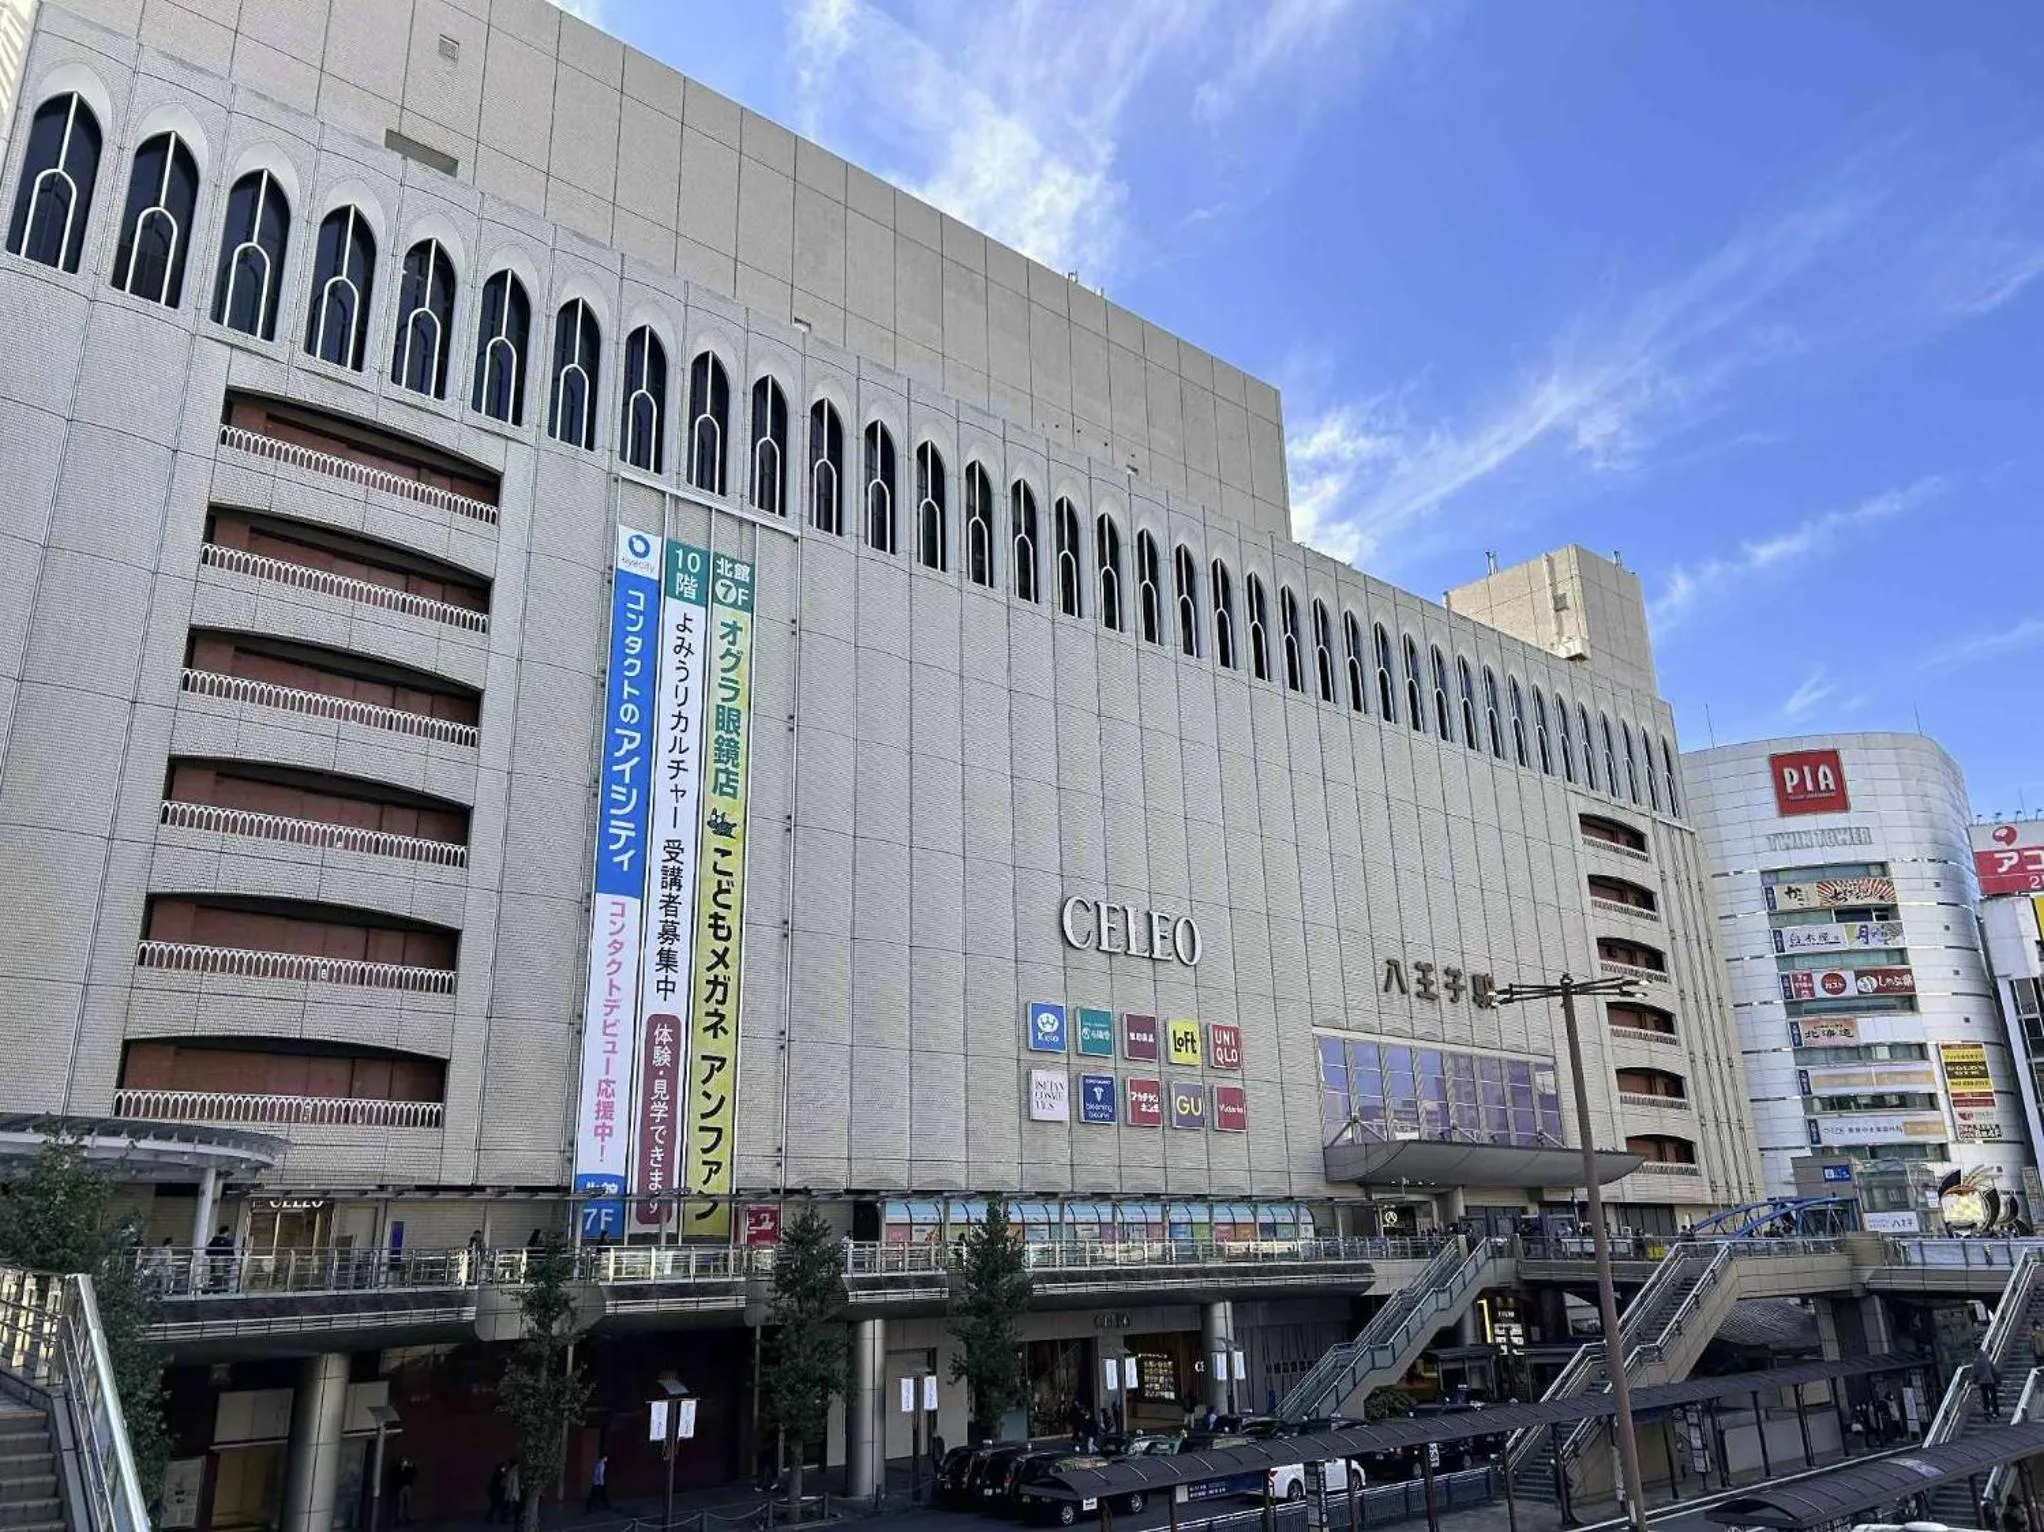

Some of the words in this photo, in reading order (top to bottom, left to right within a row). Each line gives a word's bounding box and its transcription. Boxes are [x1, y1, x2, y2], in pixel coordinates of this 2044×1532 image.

[716, 557, 751, 582] 北館
[608, 589, 645, 872] コンタクトのアイシティ
[666, 612, 695, 830] よみうりカルチャー
[712, 620, 744, 799] オグラ眼鏡店
[1783, 764, 1836, 794] PIA
[2029, 874, 2044, 888] 2
[656, 839, 685, 1002] 受講者募集中
[702, 847, 735, 1041] こどもメガネ
[1061, 895, 1203, 967] CELEO
[1214, 1029, 1236, 1046] UNI
[1217, 1047, 1238, 1064] QLO
[1176, 1095, 1202, 1116] GU
[695, 1055, 727, 1221] アンファン
[583, 1208, 615, 1231] 7F
